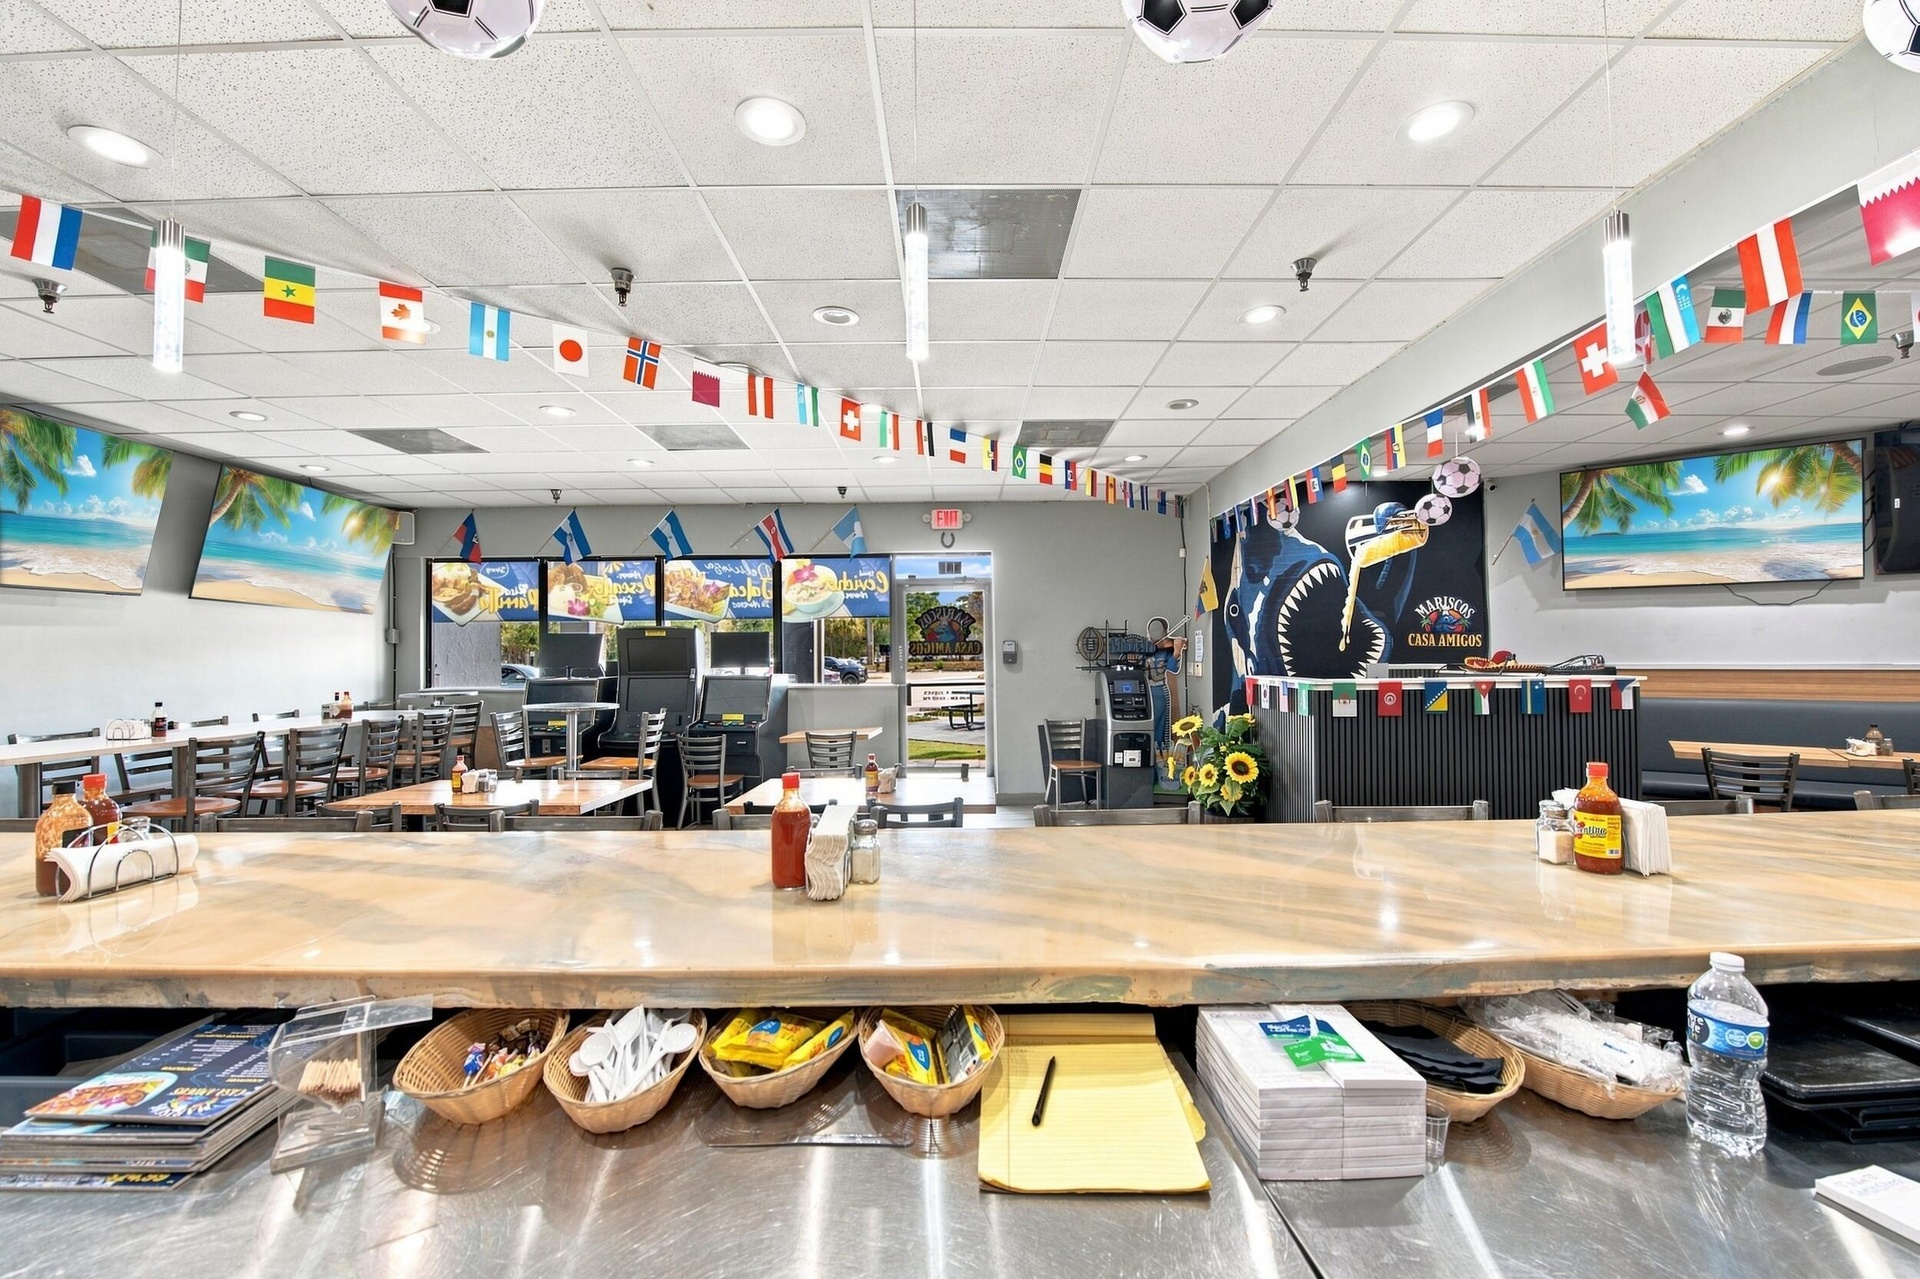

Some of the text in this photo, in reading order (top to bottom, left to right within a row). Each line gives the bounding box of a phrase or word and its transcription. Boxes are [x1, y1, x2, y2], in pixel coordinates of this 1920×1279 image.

[937, 510, 958, 527] EXIT
[1414, 595, 1476, 619] MARISCOS
[1408, 633, 1482, 647] CASA AMIGOS
